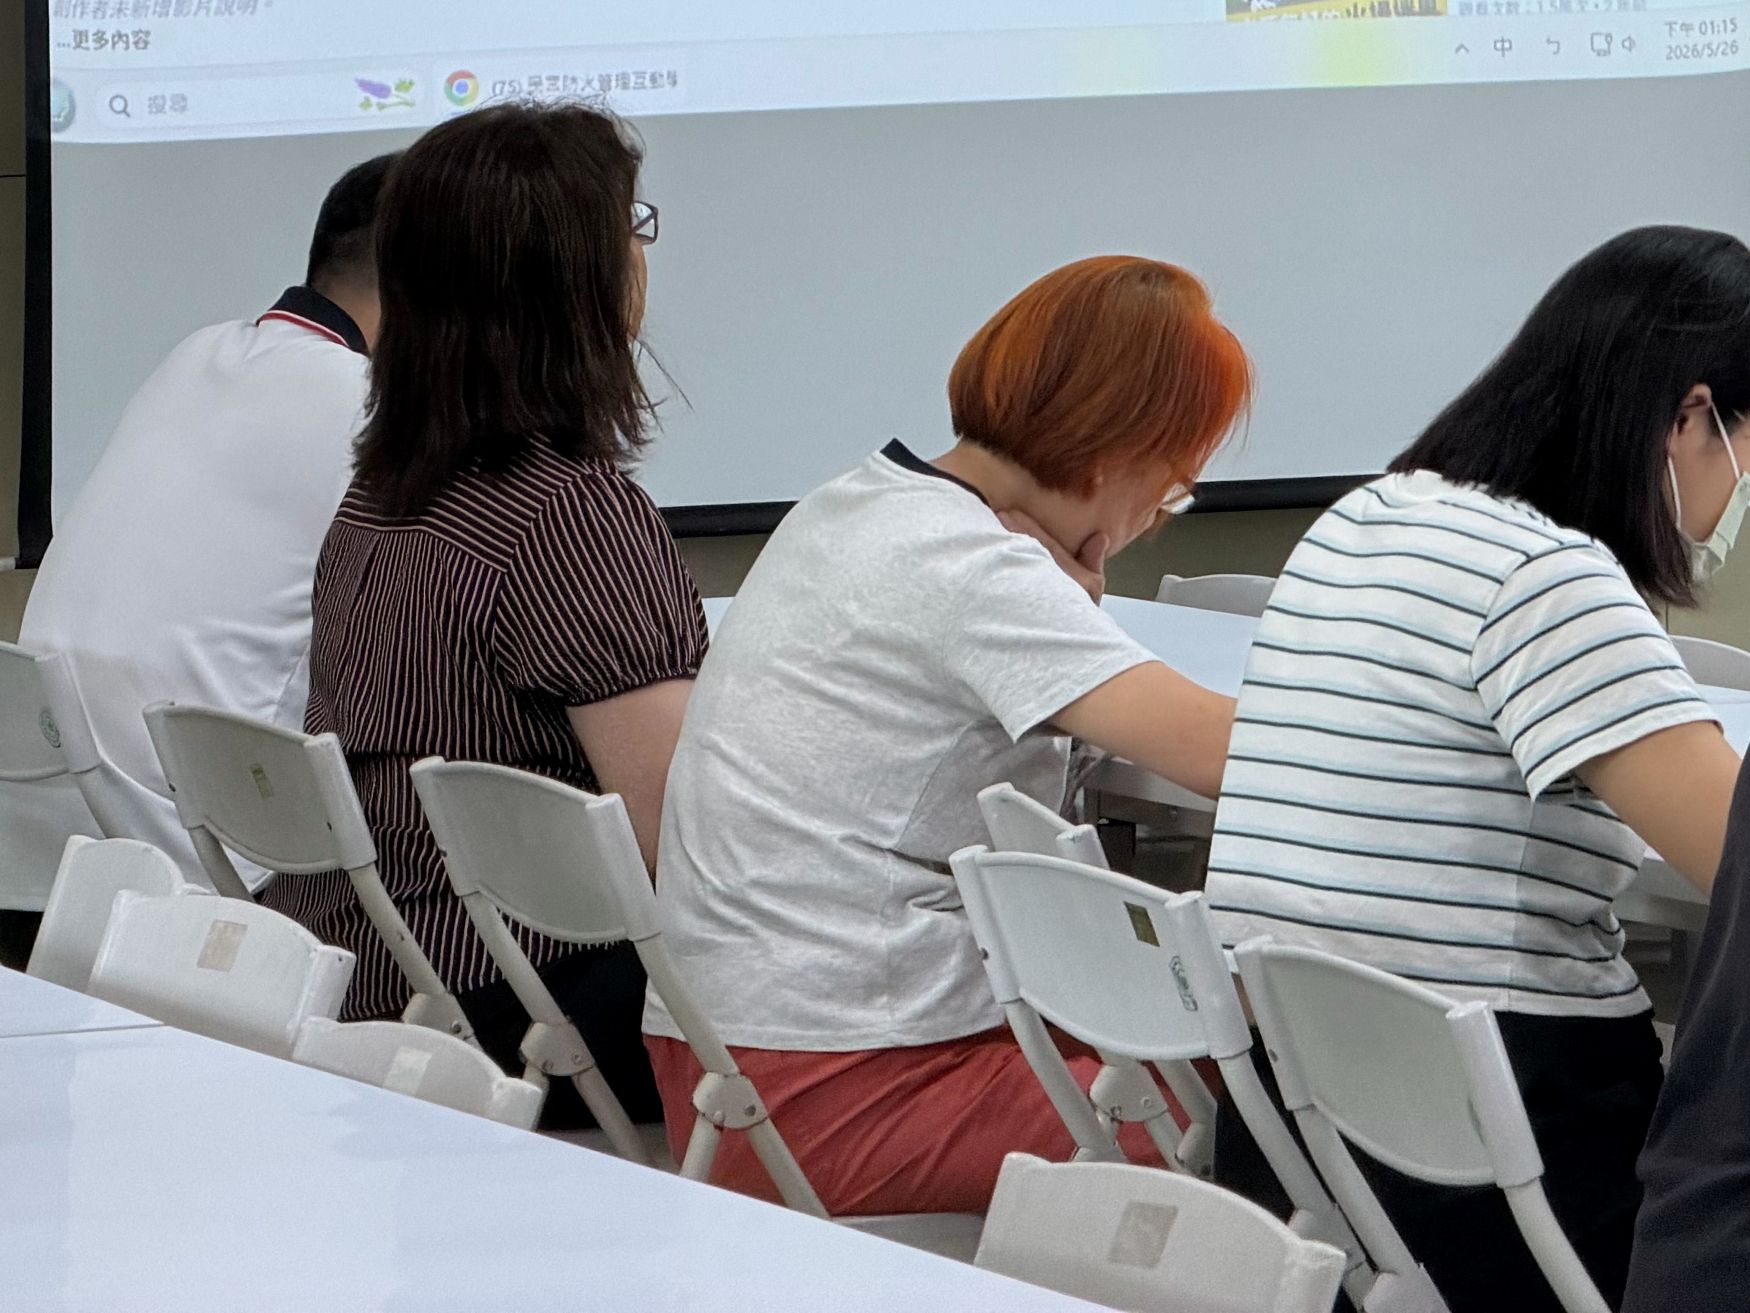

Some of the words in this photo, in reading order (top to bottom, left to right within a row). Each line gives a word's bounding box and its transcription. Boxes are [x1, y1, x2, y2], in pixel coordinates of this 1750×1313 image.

[1664, 20, 1695, 39] 下午
[1698, 17, 1738, 36] 01:15
[1493, 36, 1513, 58] 中
[1665, 40, 1739, 61] 2026/5/26
[147, 93, 189, 115] 搜尋
